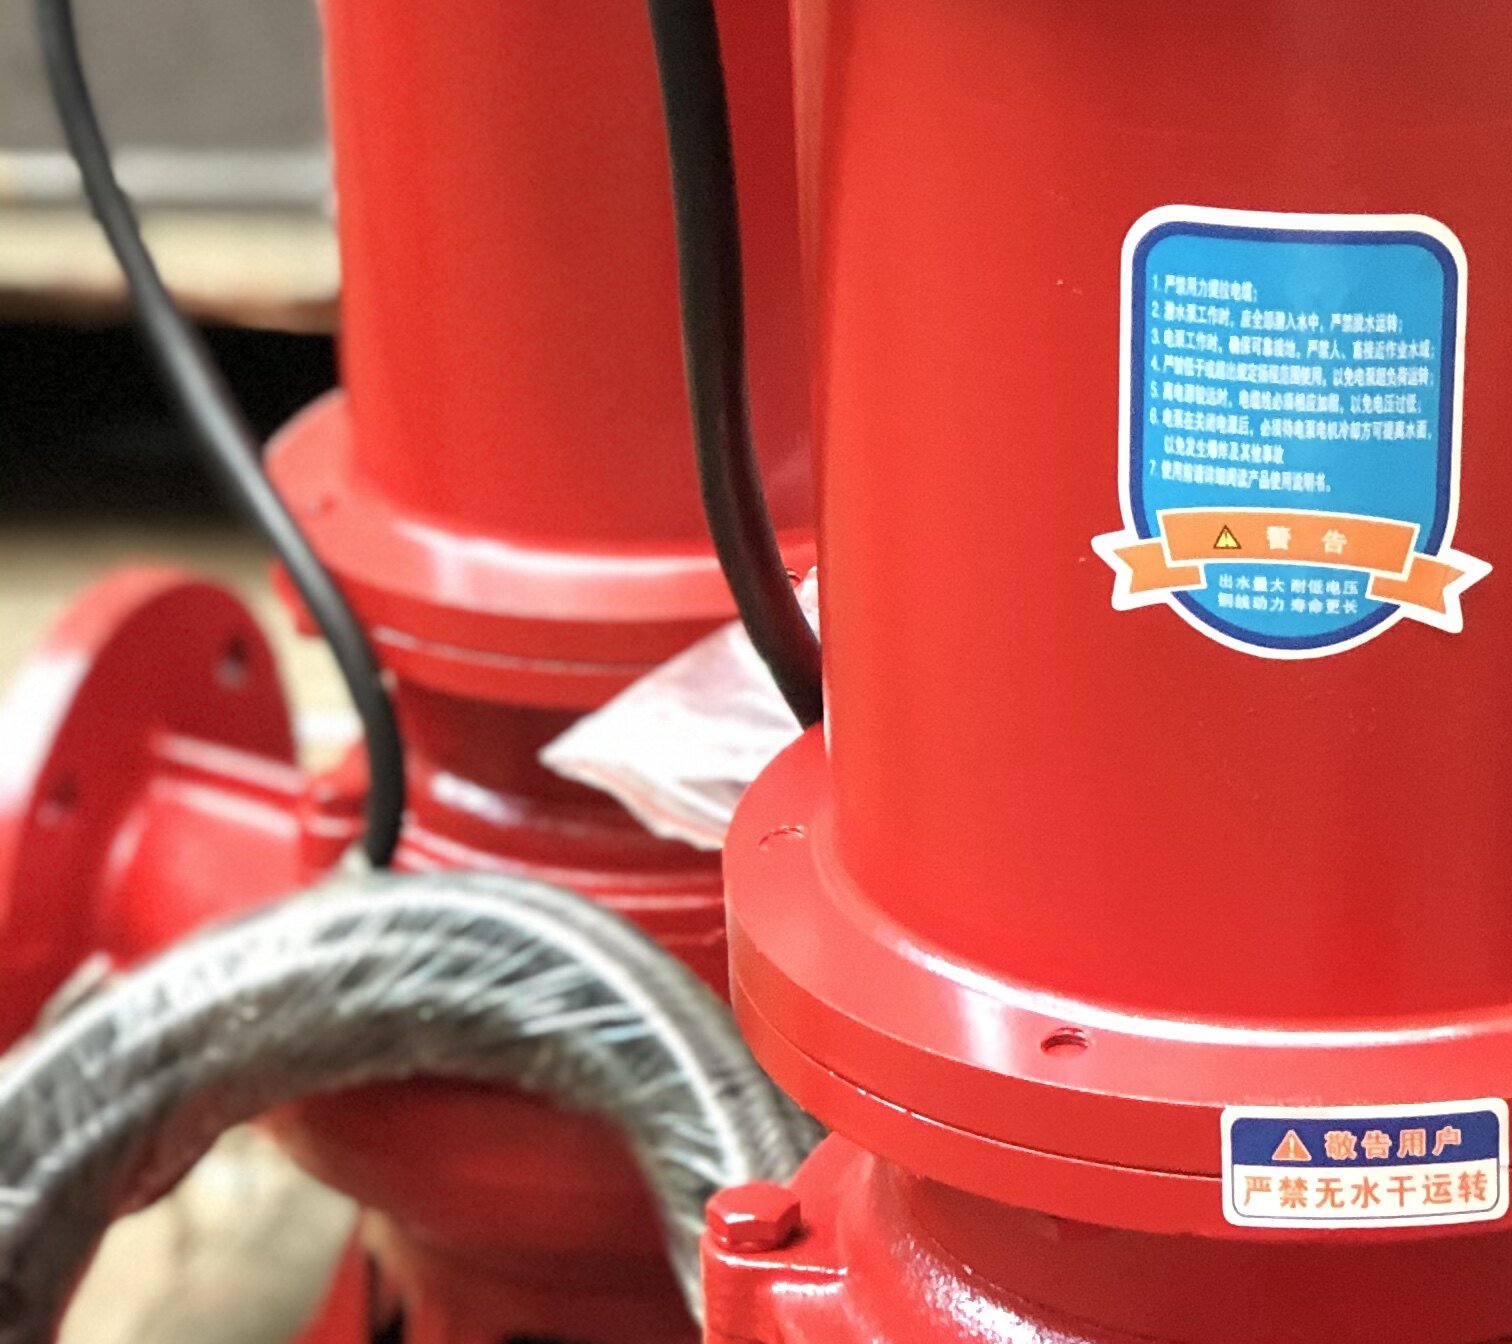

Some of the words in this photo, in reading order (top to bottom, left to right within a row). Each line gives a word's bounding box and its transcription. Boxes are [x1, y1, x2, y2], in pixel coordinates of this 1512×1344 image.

[1218, 574, 1285, 593] 出水量大
[1290, 578, 1359, 596] 耐低电压
[1323, 1124, 1464, 1161] 敬告用户
[1242, 1168, 1489, 1209] 严禁无水干运转
